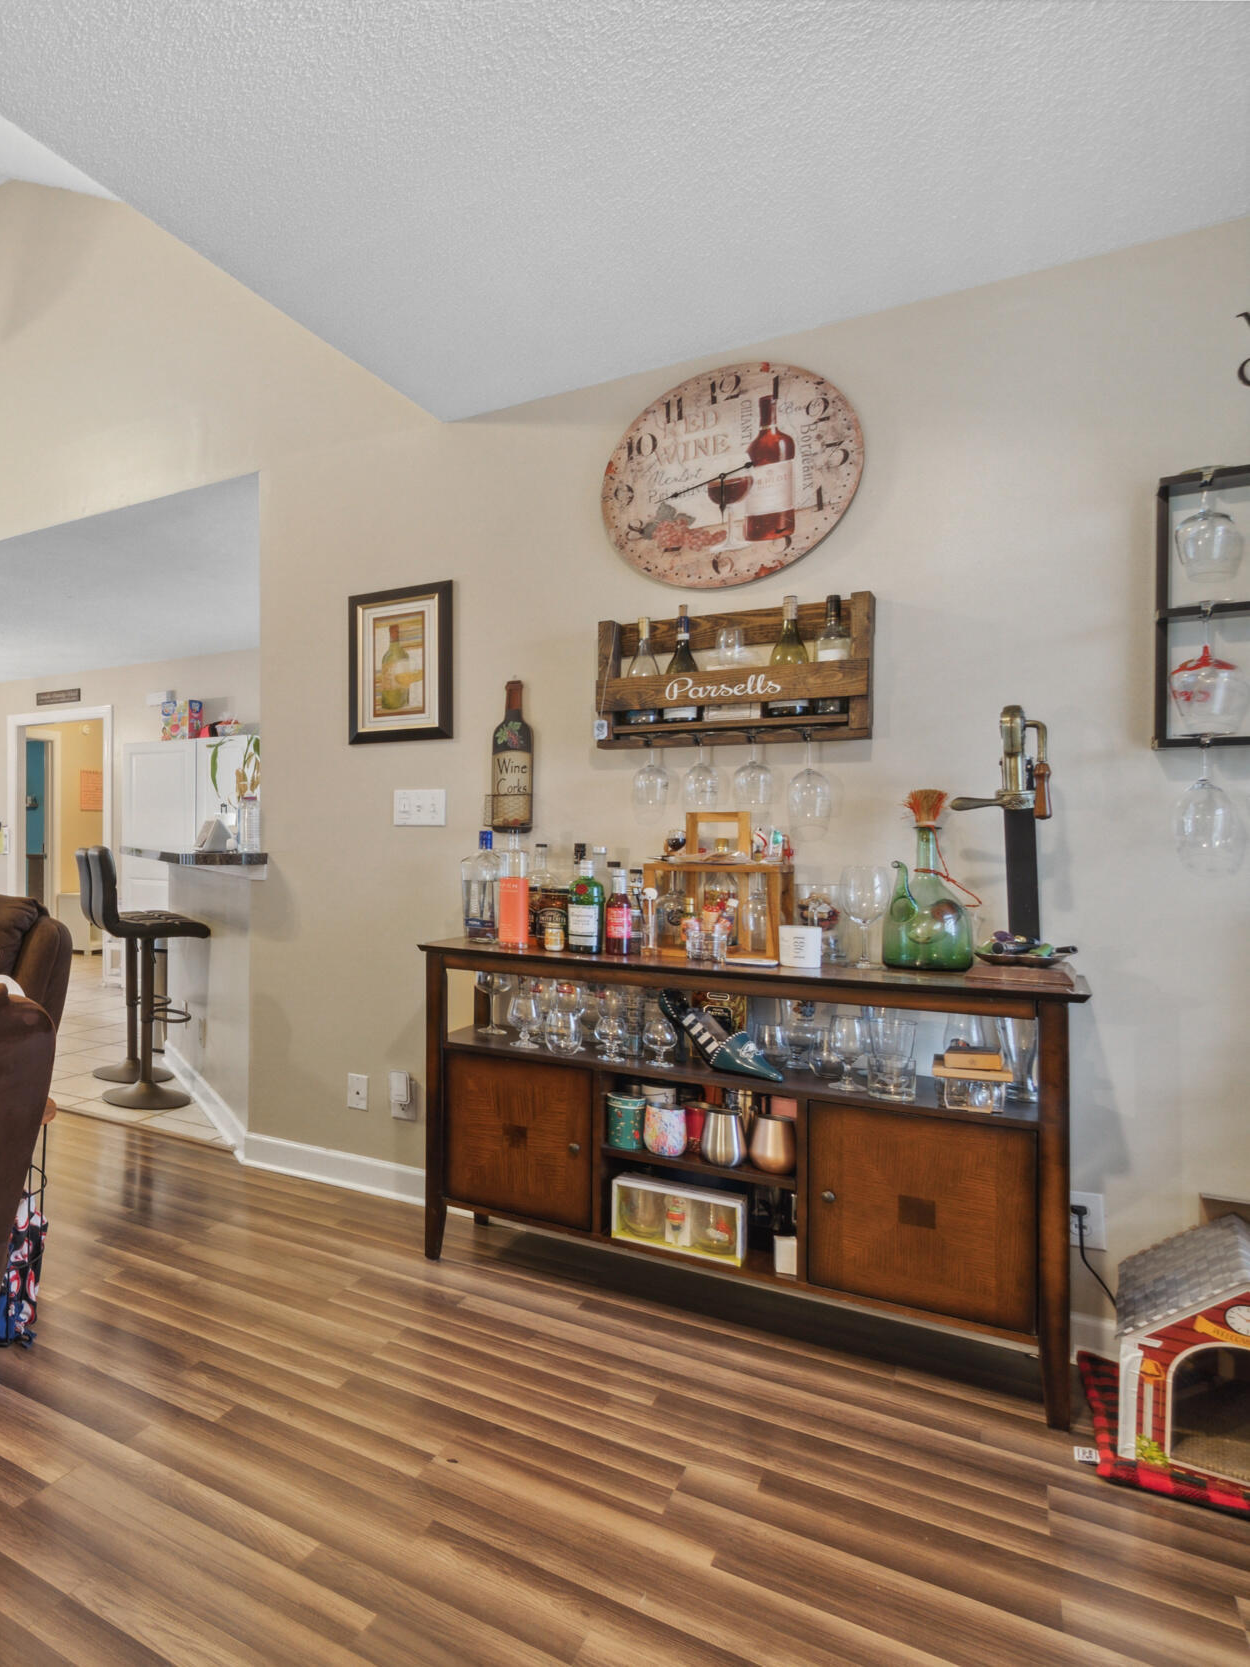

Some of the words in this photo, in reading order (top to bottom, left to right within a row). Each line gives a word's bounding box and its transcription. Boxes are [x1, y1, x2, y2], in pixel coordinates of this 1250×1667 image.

[710, 374, 741, 405] 12
[662, 397, 683, 424] 11
[740, 399, 754, 446] CHIANTI
[805, 397, 831, 424] 2
[626, 432, 658, 462] 10
[654, 434, 731, 467] WINE
[801, 423, 817, 491] Bordeaux
[665, 674, 781, 700] Parsells
[497, 758, 527, 774] Wine
[497, 778, 527, 795] Corks
